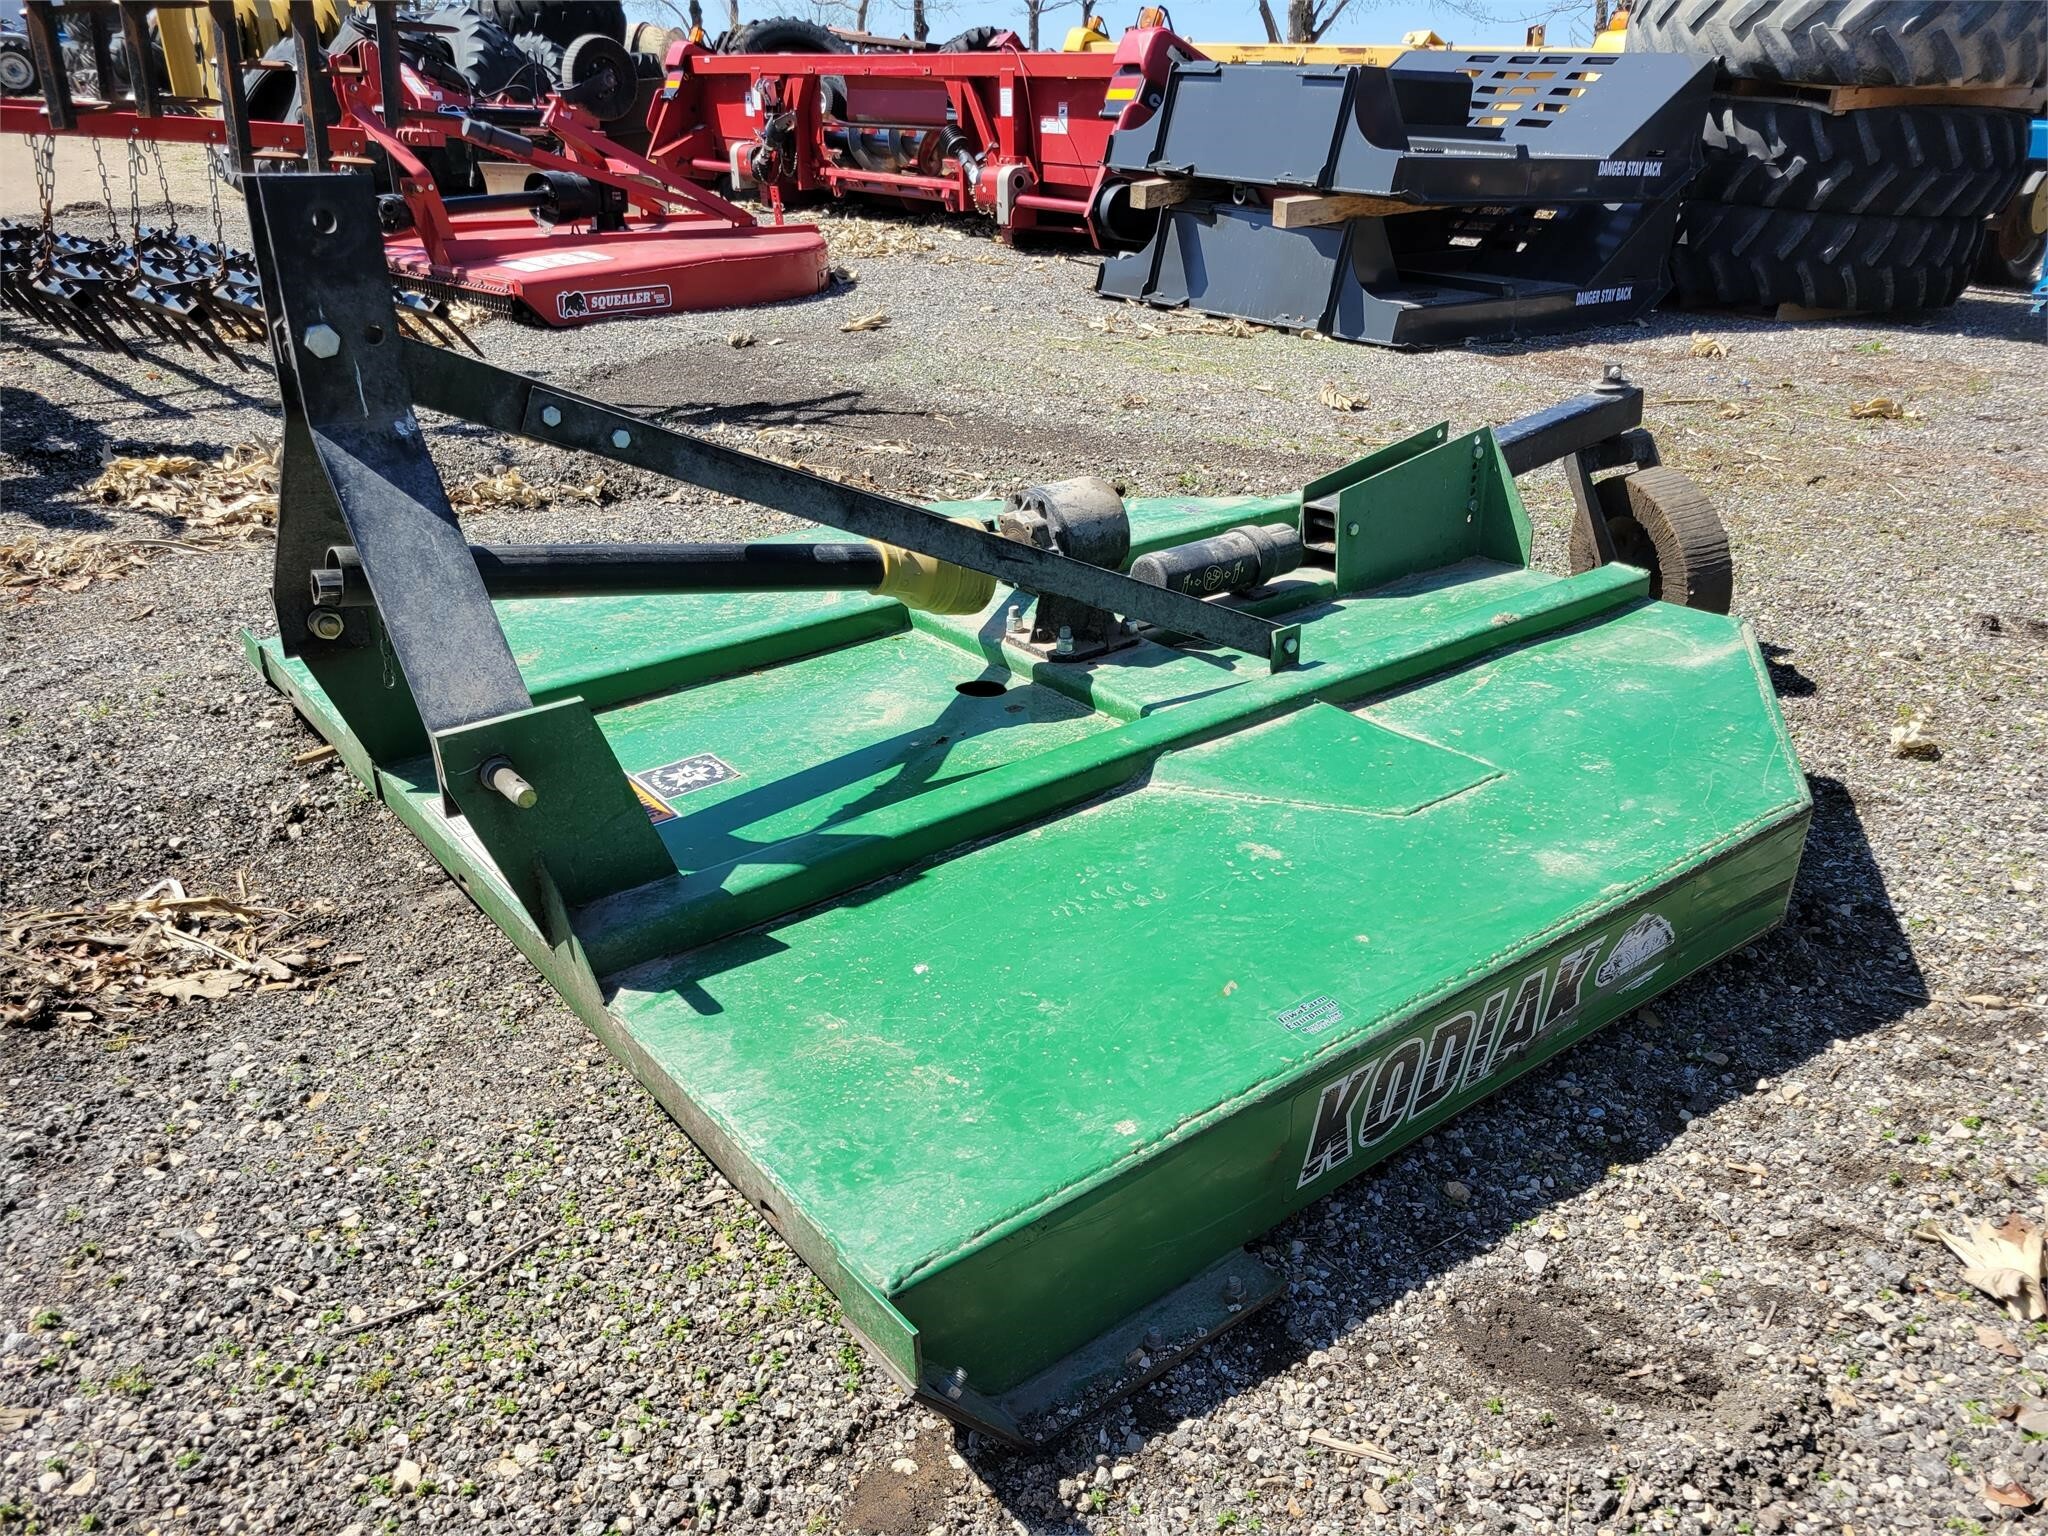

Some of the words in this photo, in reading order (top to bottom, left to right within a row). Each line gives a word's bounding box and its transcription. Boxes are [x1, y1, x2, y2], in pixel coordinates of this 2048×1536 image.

[1598, 161, 1626, 176] DANGER
[1626, 161, 1644, 176] STAY
[1643, 162, 1662, 176] BACK
[591, 292, 651, 309] SQUEALER
[1576, 291, 1600, 306] DANGER
[1601, 288, 1616, 303] STAY
[1616, 287, 1632, 301] BACK
[1284, 1000, 1338, 1030] Equipment
[1297, 935, 1607, 1190] KODIAK
